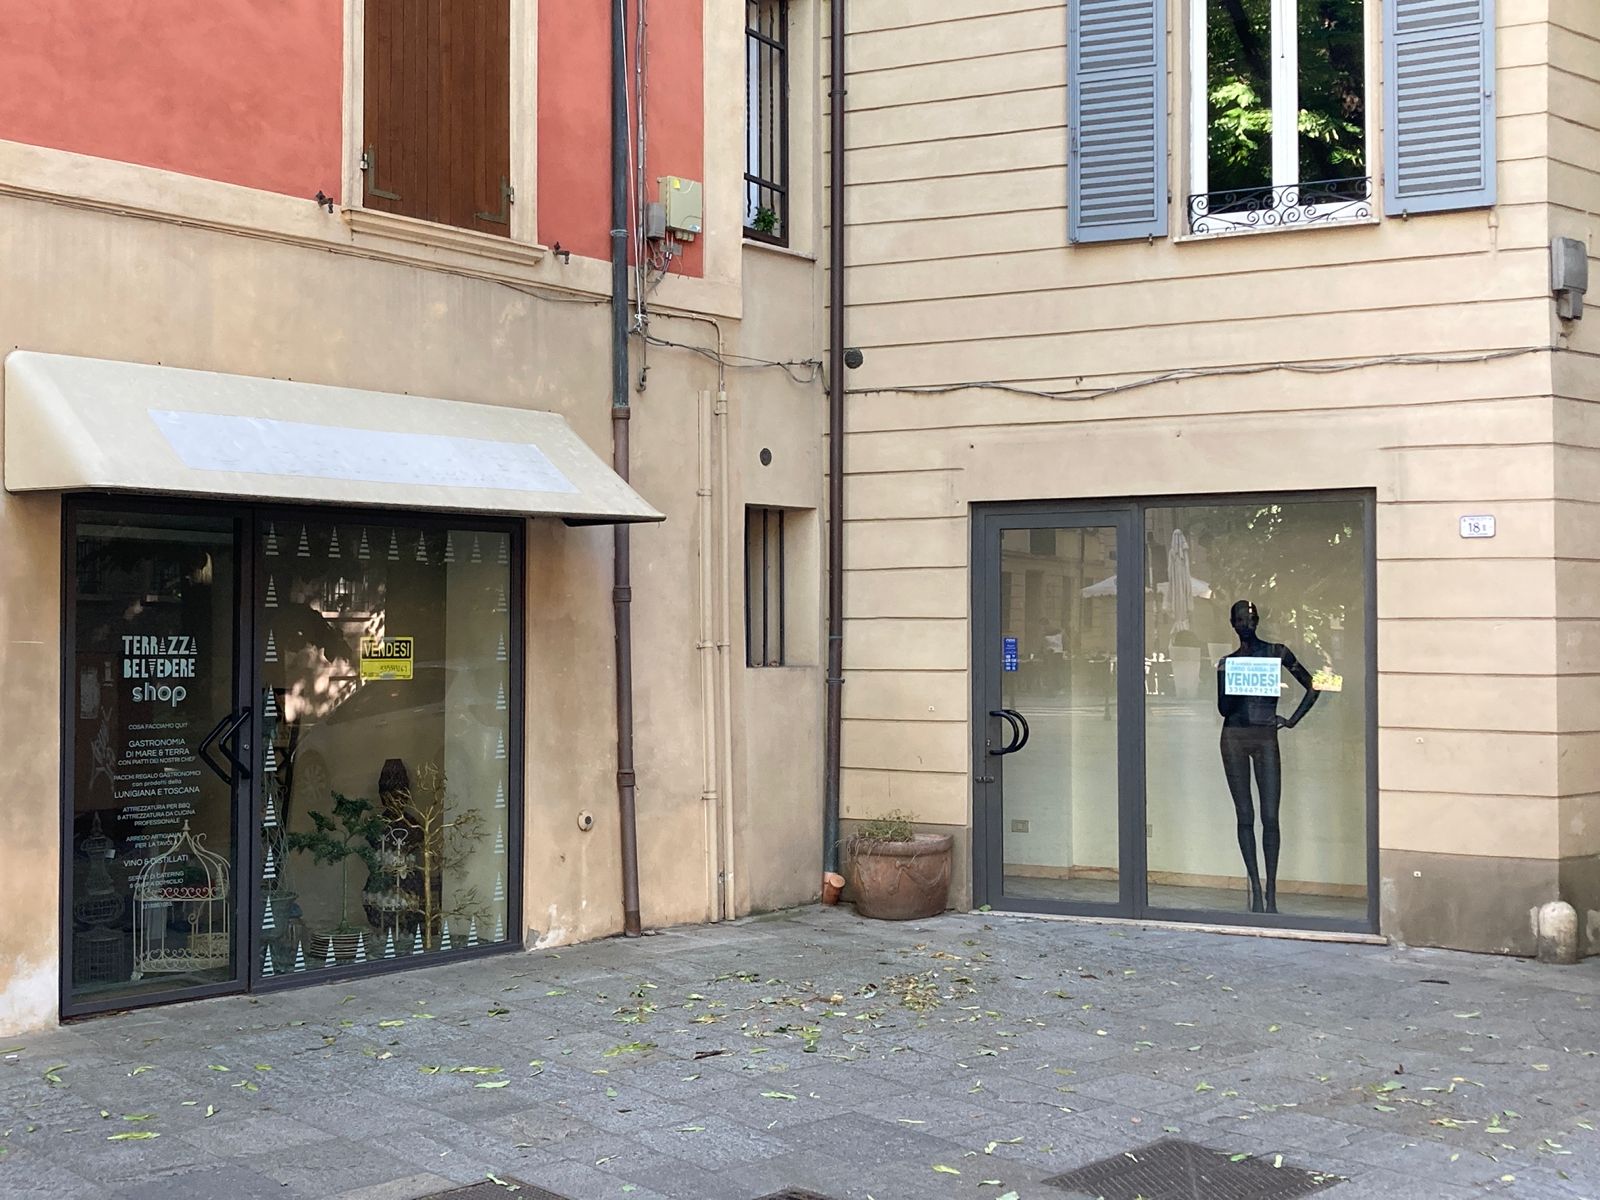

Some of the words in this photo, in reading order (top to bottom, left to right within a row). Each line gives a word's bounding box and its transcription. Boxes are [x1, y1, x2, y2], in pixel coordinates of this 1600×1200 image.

[1468, 522, 1480, 533] 18
[122, 635, 198, 655] TERRAZZA
[364, 642, 410, 657] VENDESI
[124, 658, 196, 678] BELVEDERE
[1227, 673, 1279, 687] VENDESI
[132, 682, 187, 707] shop
[129, 738, 186, 747] GASTRONOMIA
[126, 750, 134, 758] DI
[114, 789, 156, 798] LUNIGIANA
[164, 786, 200, 795] TOSCANA
[123, 804, 165, 812] ATTREZZATURA
[122, 811, 165, 819] ATTREZZATURA
[134, 818, 180, 826] PROFESSIONALE
[123, 859, 143, 867] VINO
